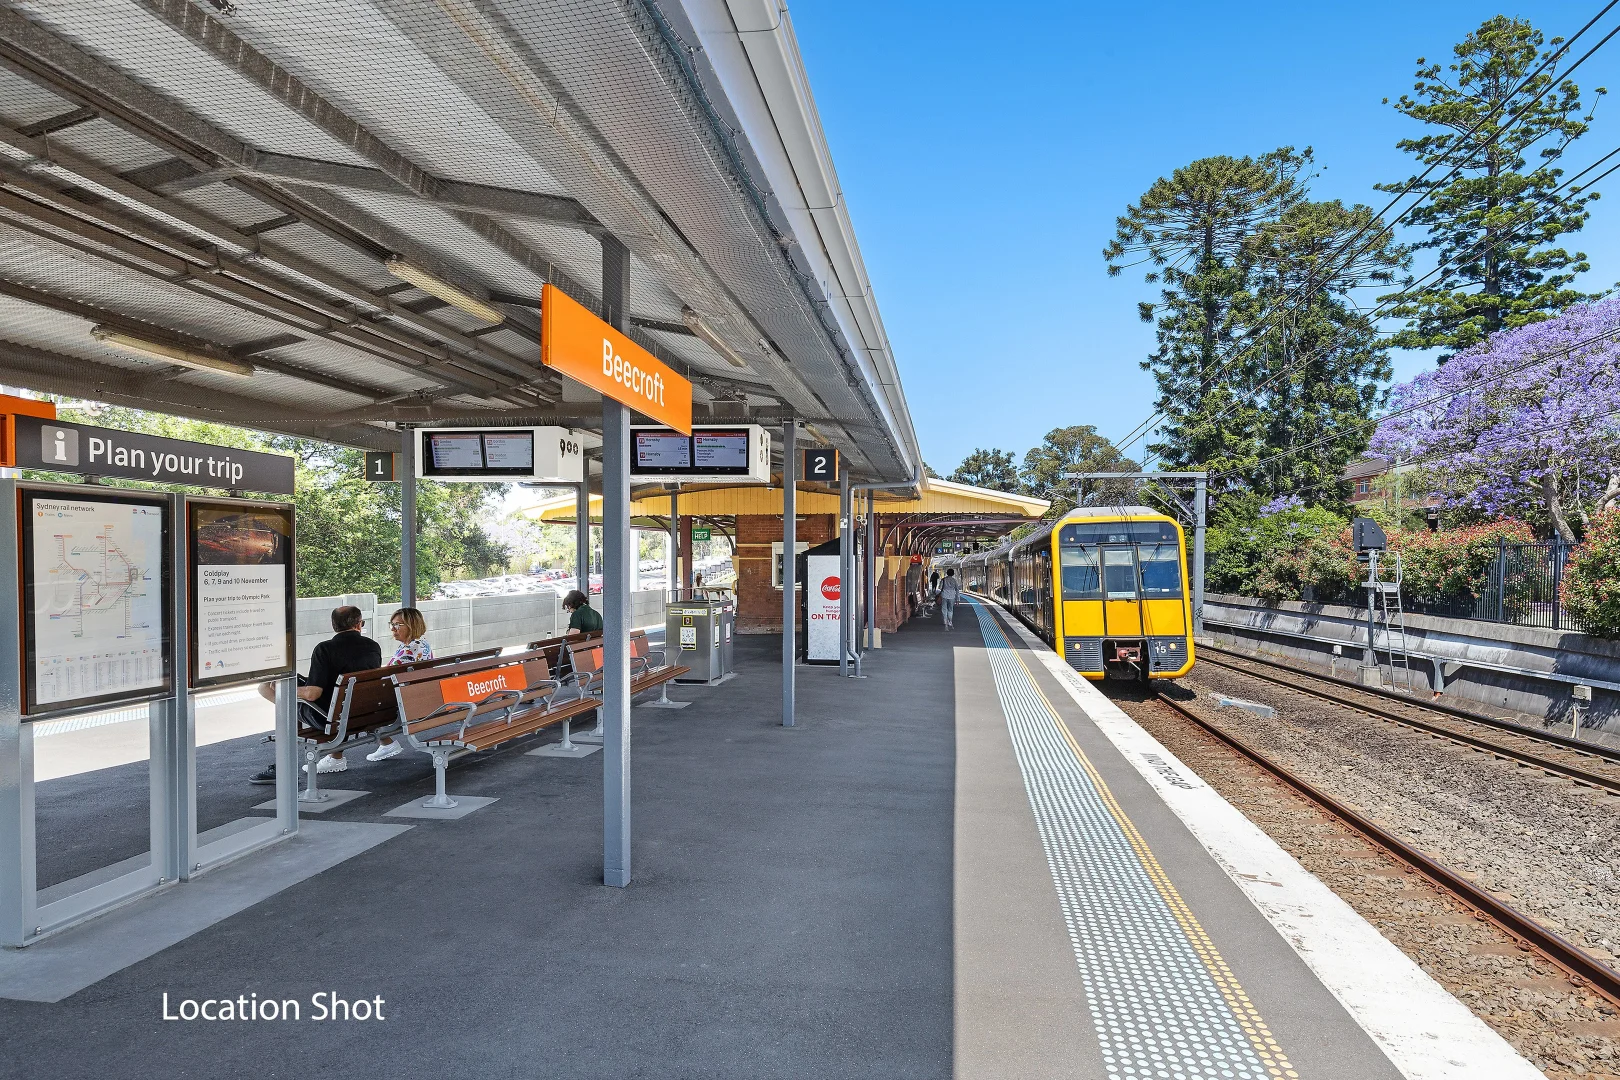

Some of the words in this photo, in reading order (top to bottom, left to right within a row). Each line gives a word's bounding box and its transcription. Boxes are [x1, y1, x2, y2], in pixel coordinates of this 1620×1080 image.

[603, 338, 665, 407] Beecroft
[89, 438, 145, 469] Plan
[151, 451, 203, 476] your
[208, 457, 243, 484] trip
[375, 459, 384, 474] 1
[814, 456, 826, 473] 2
[36, 503, 59, 511] Sydney
[467, 675, 507, 696] Beecroft
